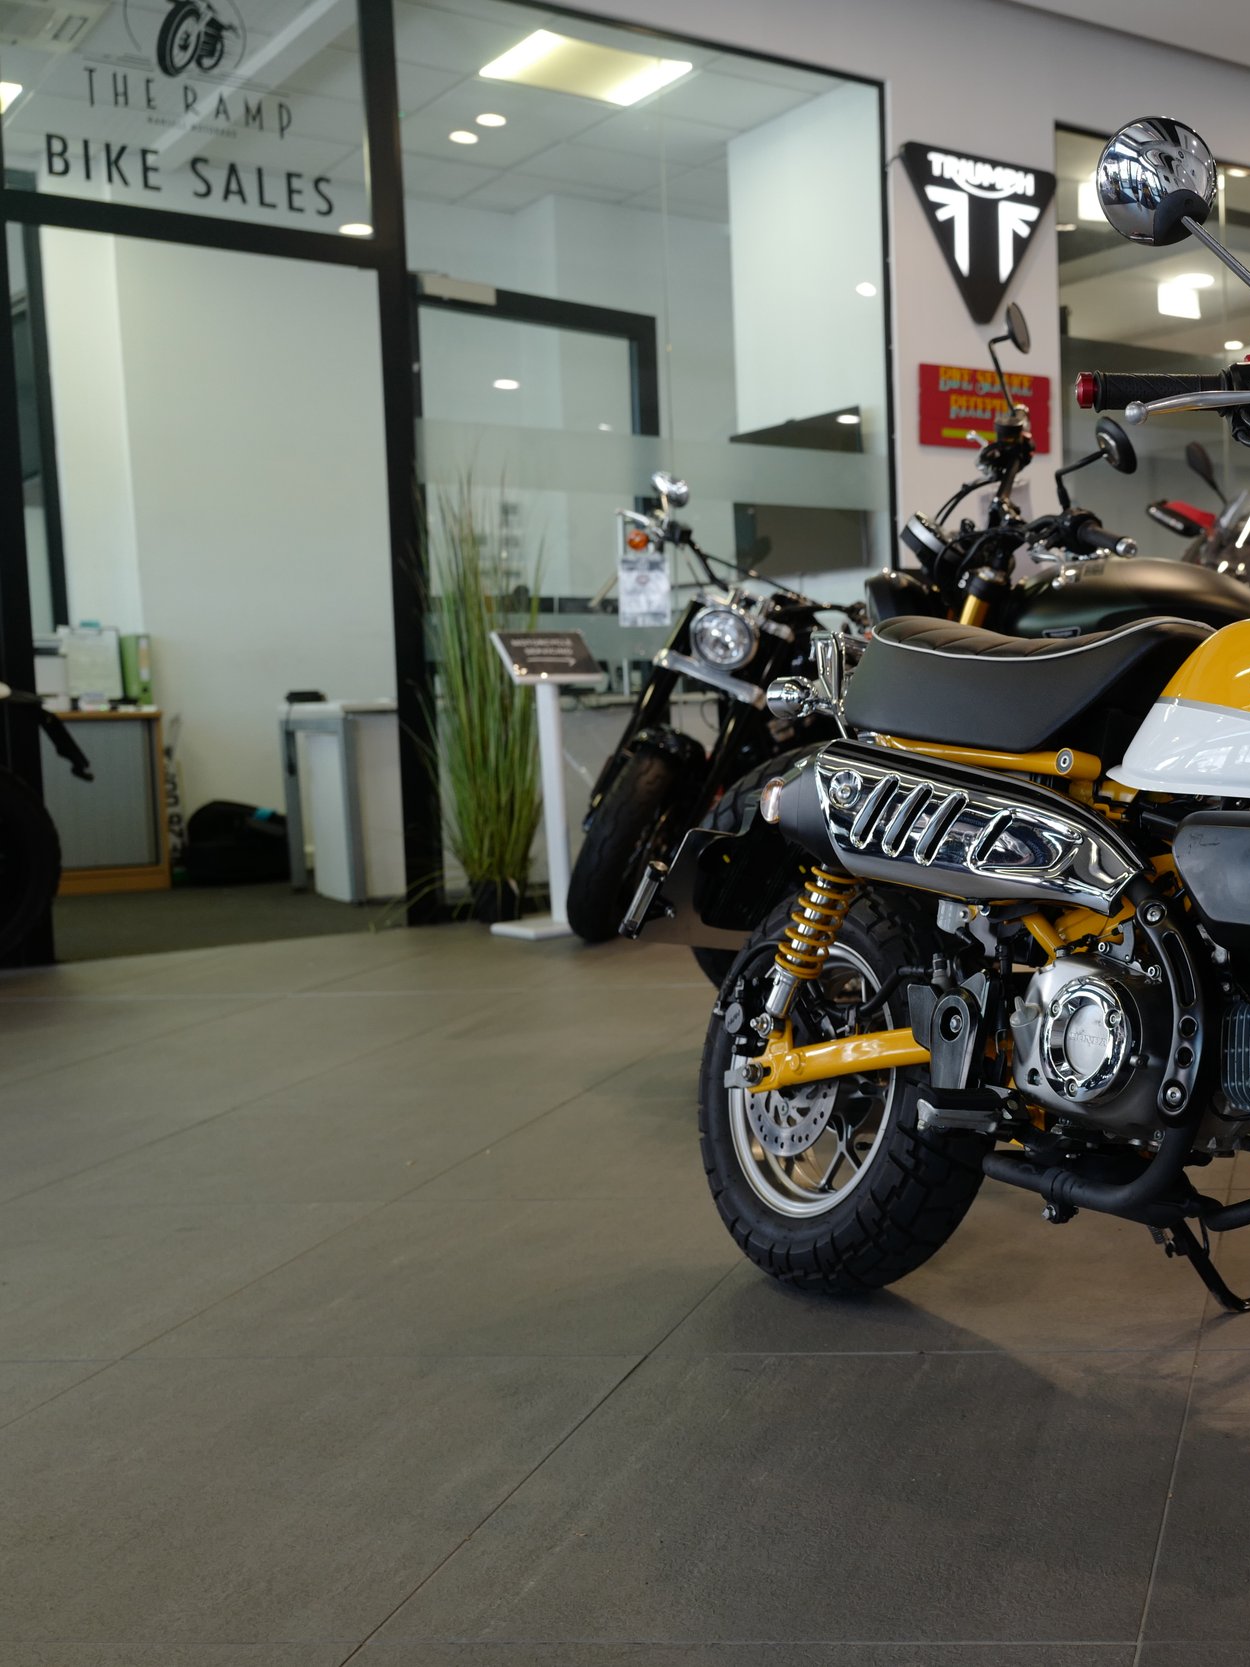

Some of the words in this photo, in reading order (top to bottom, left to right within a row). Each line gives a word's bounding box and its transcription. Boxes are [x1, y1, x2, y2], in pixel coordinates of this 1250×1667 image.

[84, 66, 157, 110] THE
[183, 84, 293, 140] RAMP
[46, 133, 163, 192] BIKE
[190, 157, 334, 216] SALES
[927, 151, 1035, 198] TRIUMPH
